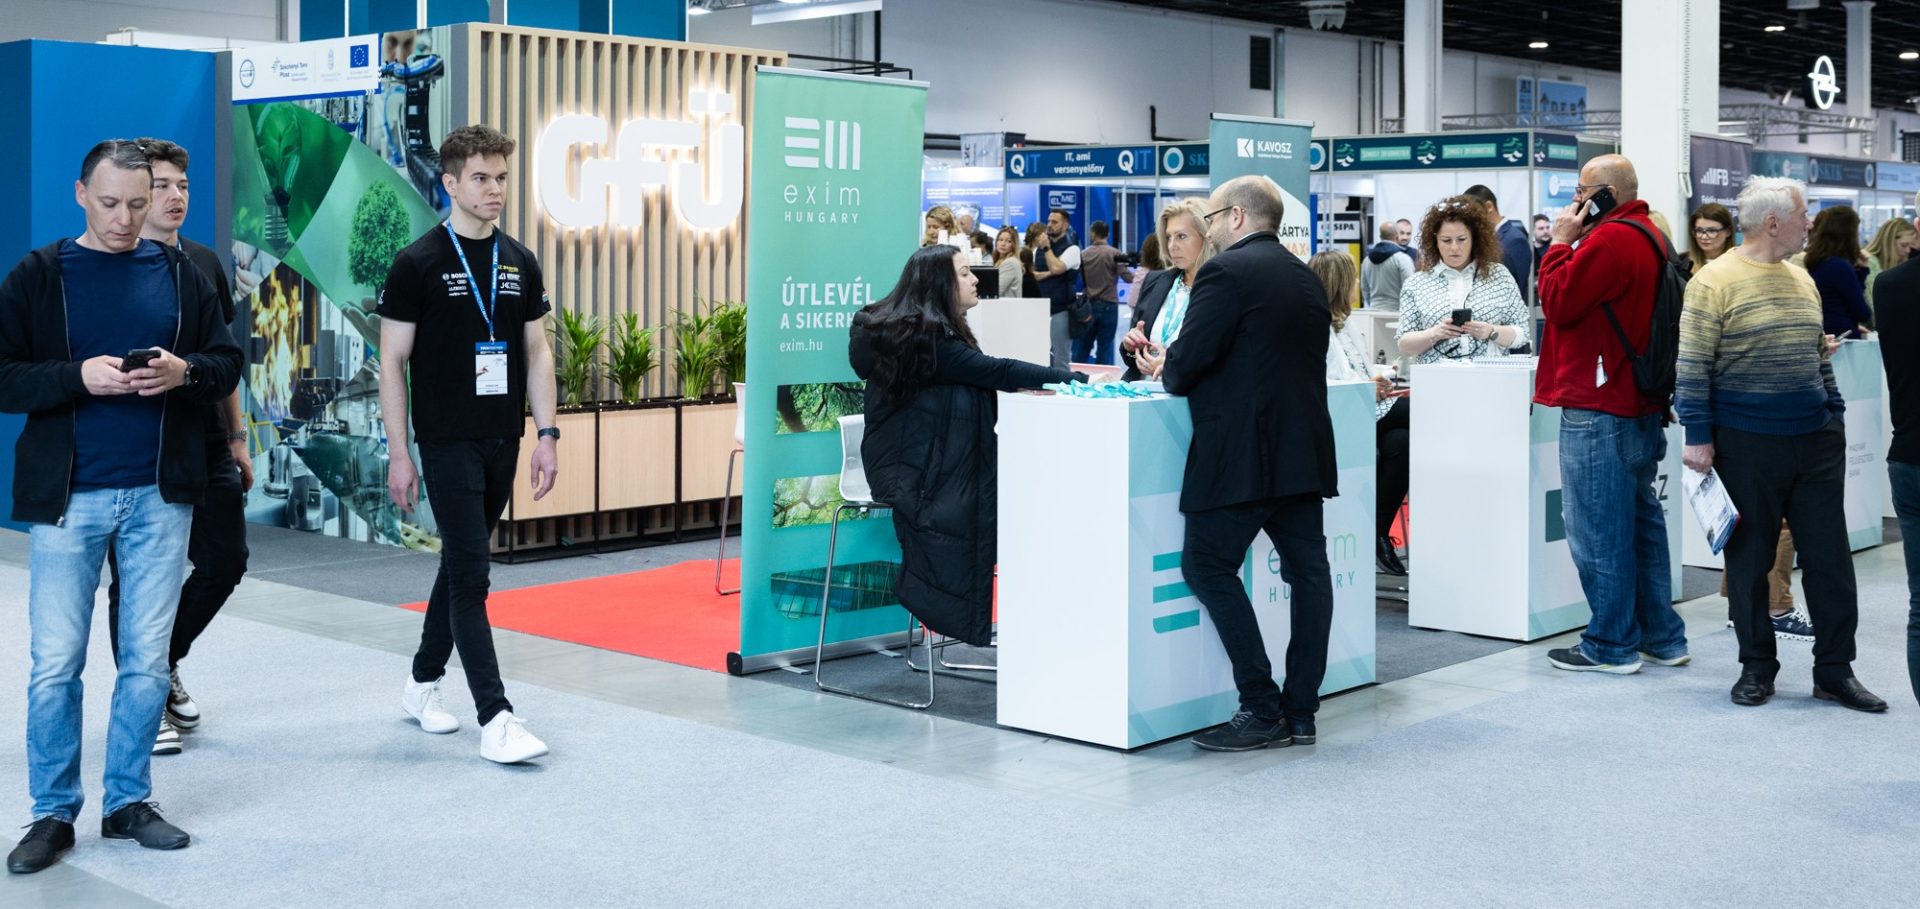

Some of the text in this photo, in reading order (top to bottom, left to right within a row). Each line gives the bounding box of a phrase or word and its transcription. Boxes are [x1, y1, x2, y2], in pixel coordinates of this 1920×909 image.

[1257, 141, 1293, 154] KAVOSZ
[538, 90, 744, 229] GFÜ
[1076, 152, 1091, 162] ami
[1118, 149, 1151, 174] QIT
[1189, 153, 1209, 166] SK
[1010, 153, 1041, 177] QIT
[1054, 162, 1105, 175] versenyelőny
[783, 181, 860, 206] exim
[784, 211, 859, 224] HUNGARY
[782, 275, 877, 306] ÚTLEVÉL
[780, 312, 790, 329] A
[780, 338, 823, 352] exim.hu
